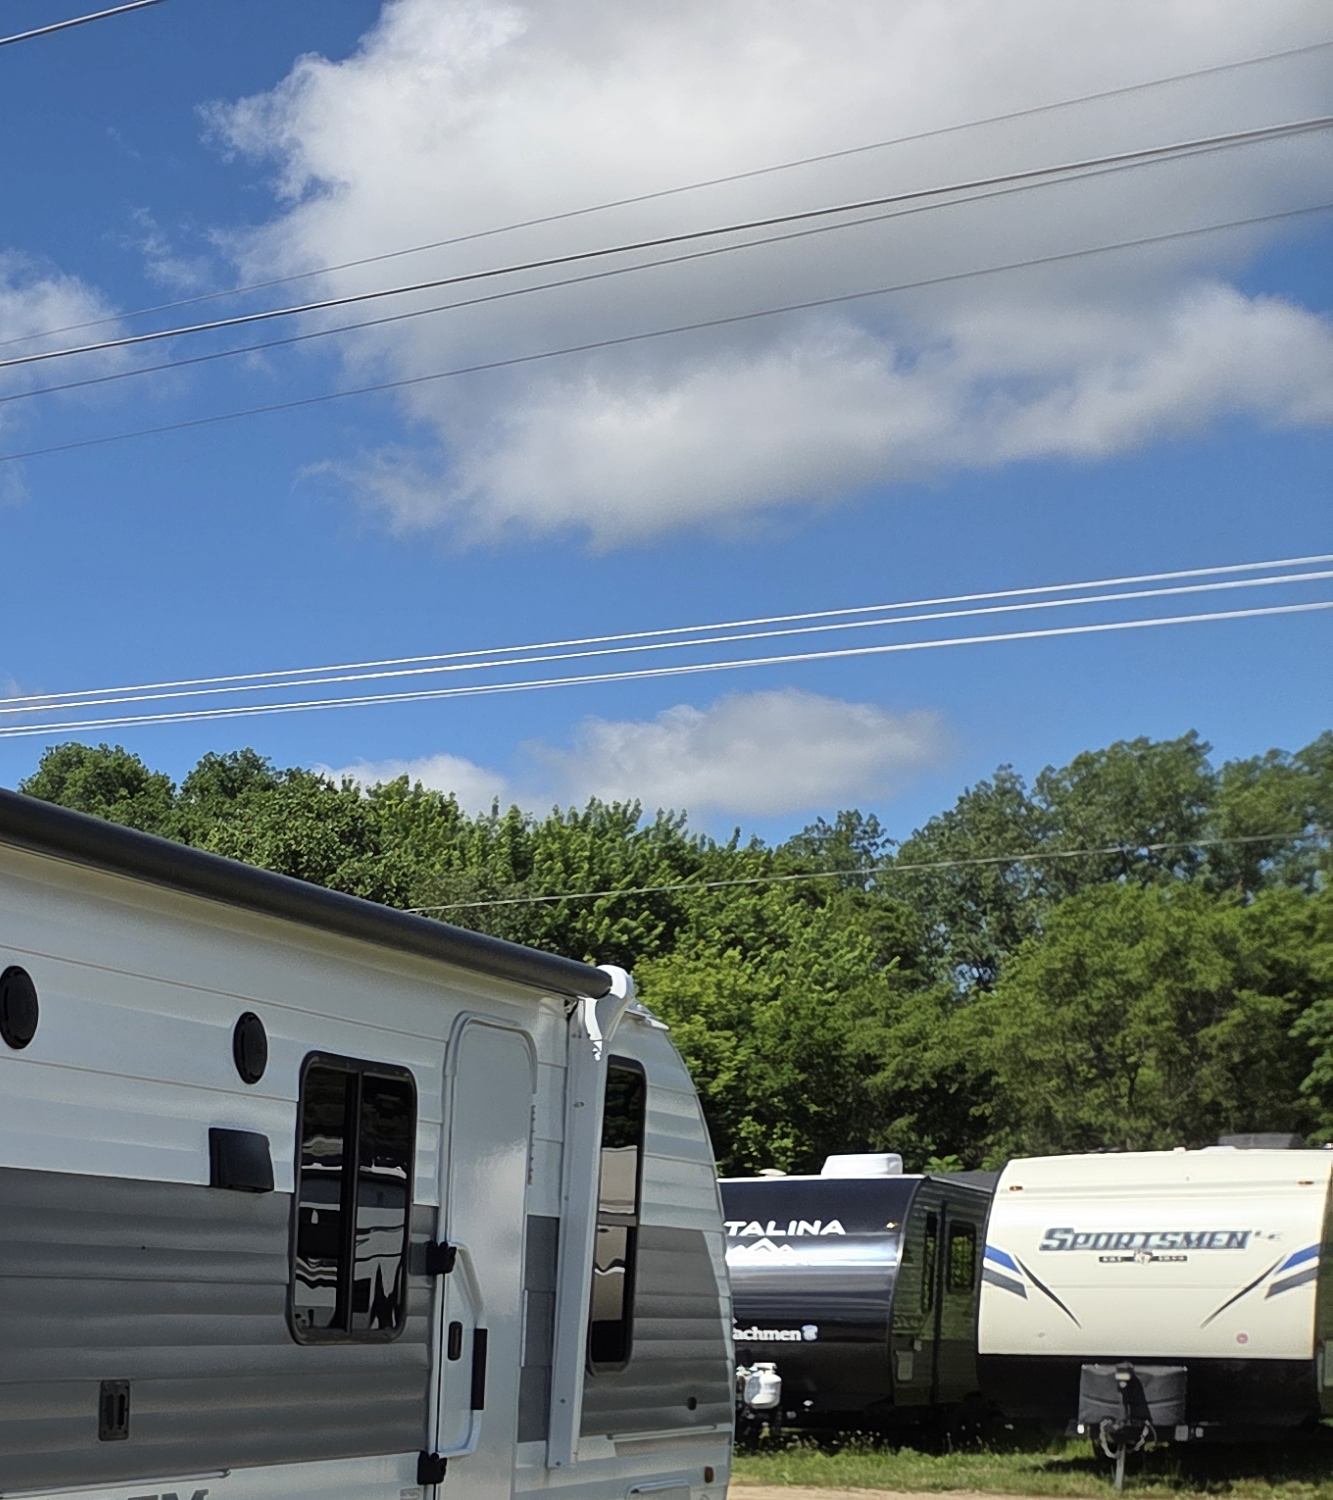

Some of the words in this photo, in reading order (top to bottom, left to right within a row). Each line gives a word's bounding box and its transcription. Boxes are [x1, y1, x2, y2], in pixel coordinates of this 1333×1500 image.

[723, 1219, 847, 1237] TALINA
[1039, 1228, 1252, 1251] SPORTSMEN
[733, 1325, 802, 1341] achmen
